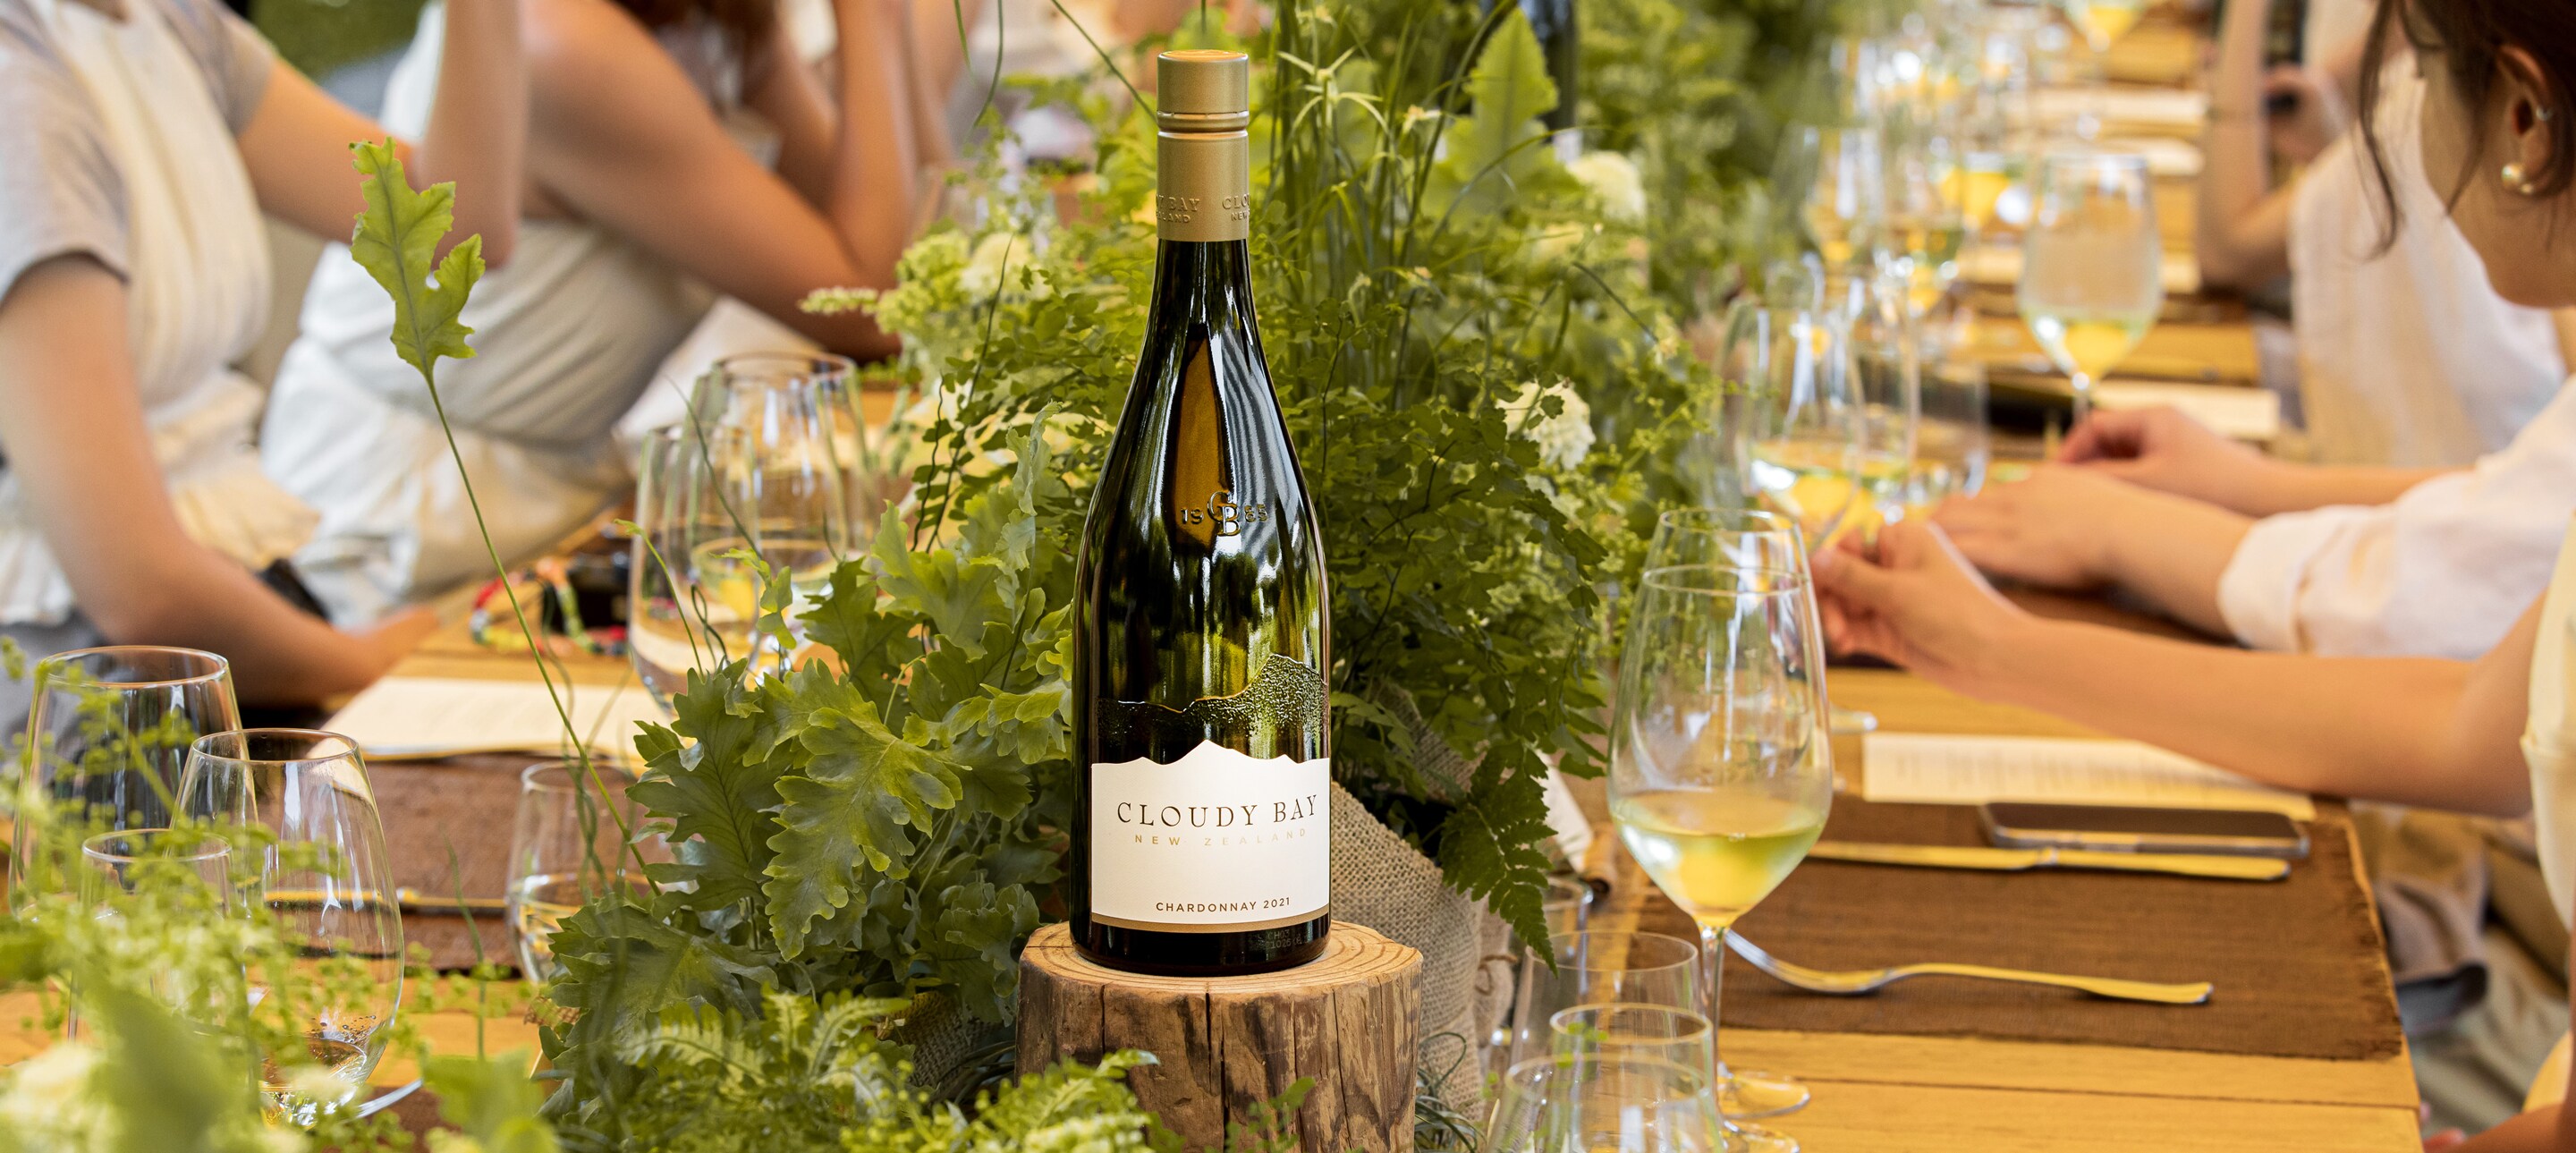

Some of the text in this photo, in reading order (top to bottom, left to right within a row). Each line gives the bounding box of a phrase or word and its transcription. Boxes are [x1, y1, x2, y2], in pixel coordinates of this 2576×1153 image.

[1168, 196, 1200, 213] BAY
[1181, 505, 1204, 525] 19
[1117, 794, 1317, 827] CLOUDY BAY
[1135, 828, 1306, 846] NEW ZEALAND
[1156, 896, 1290, 912] CHARDONNAY 2021
